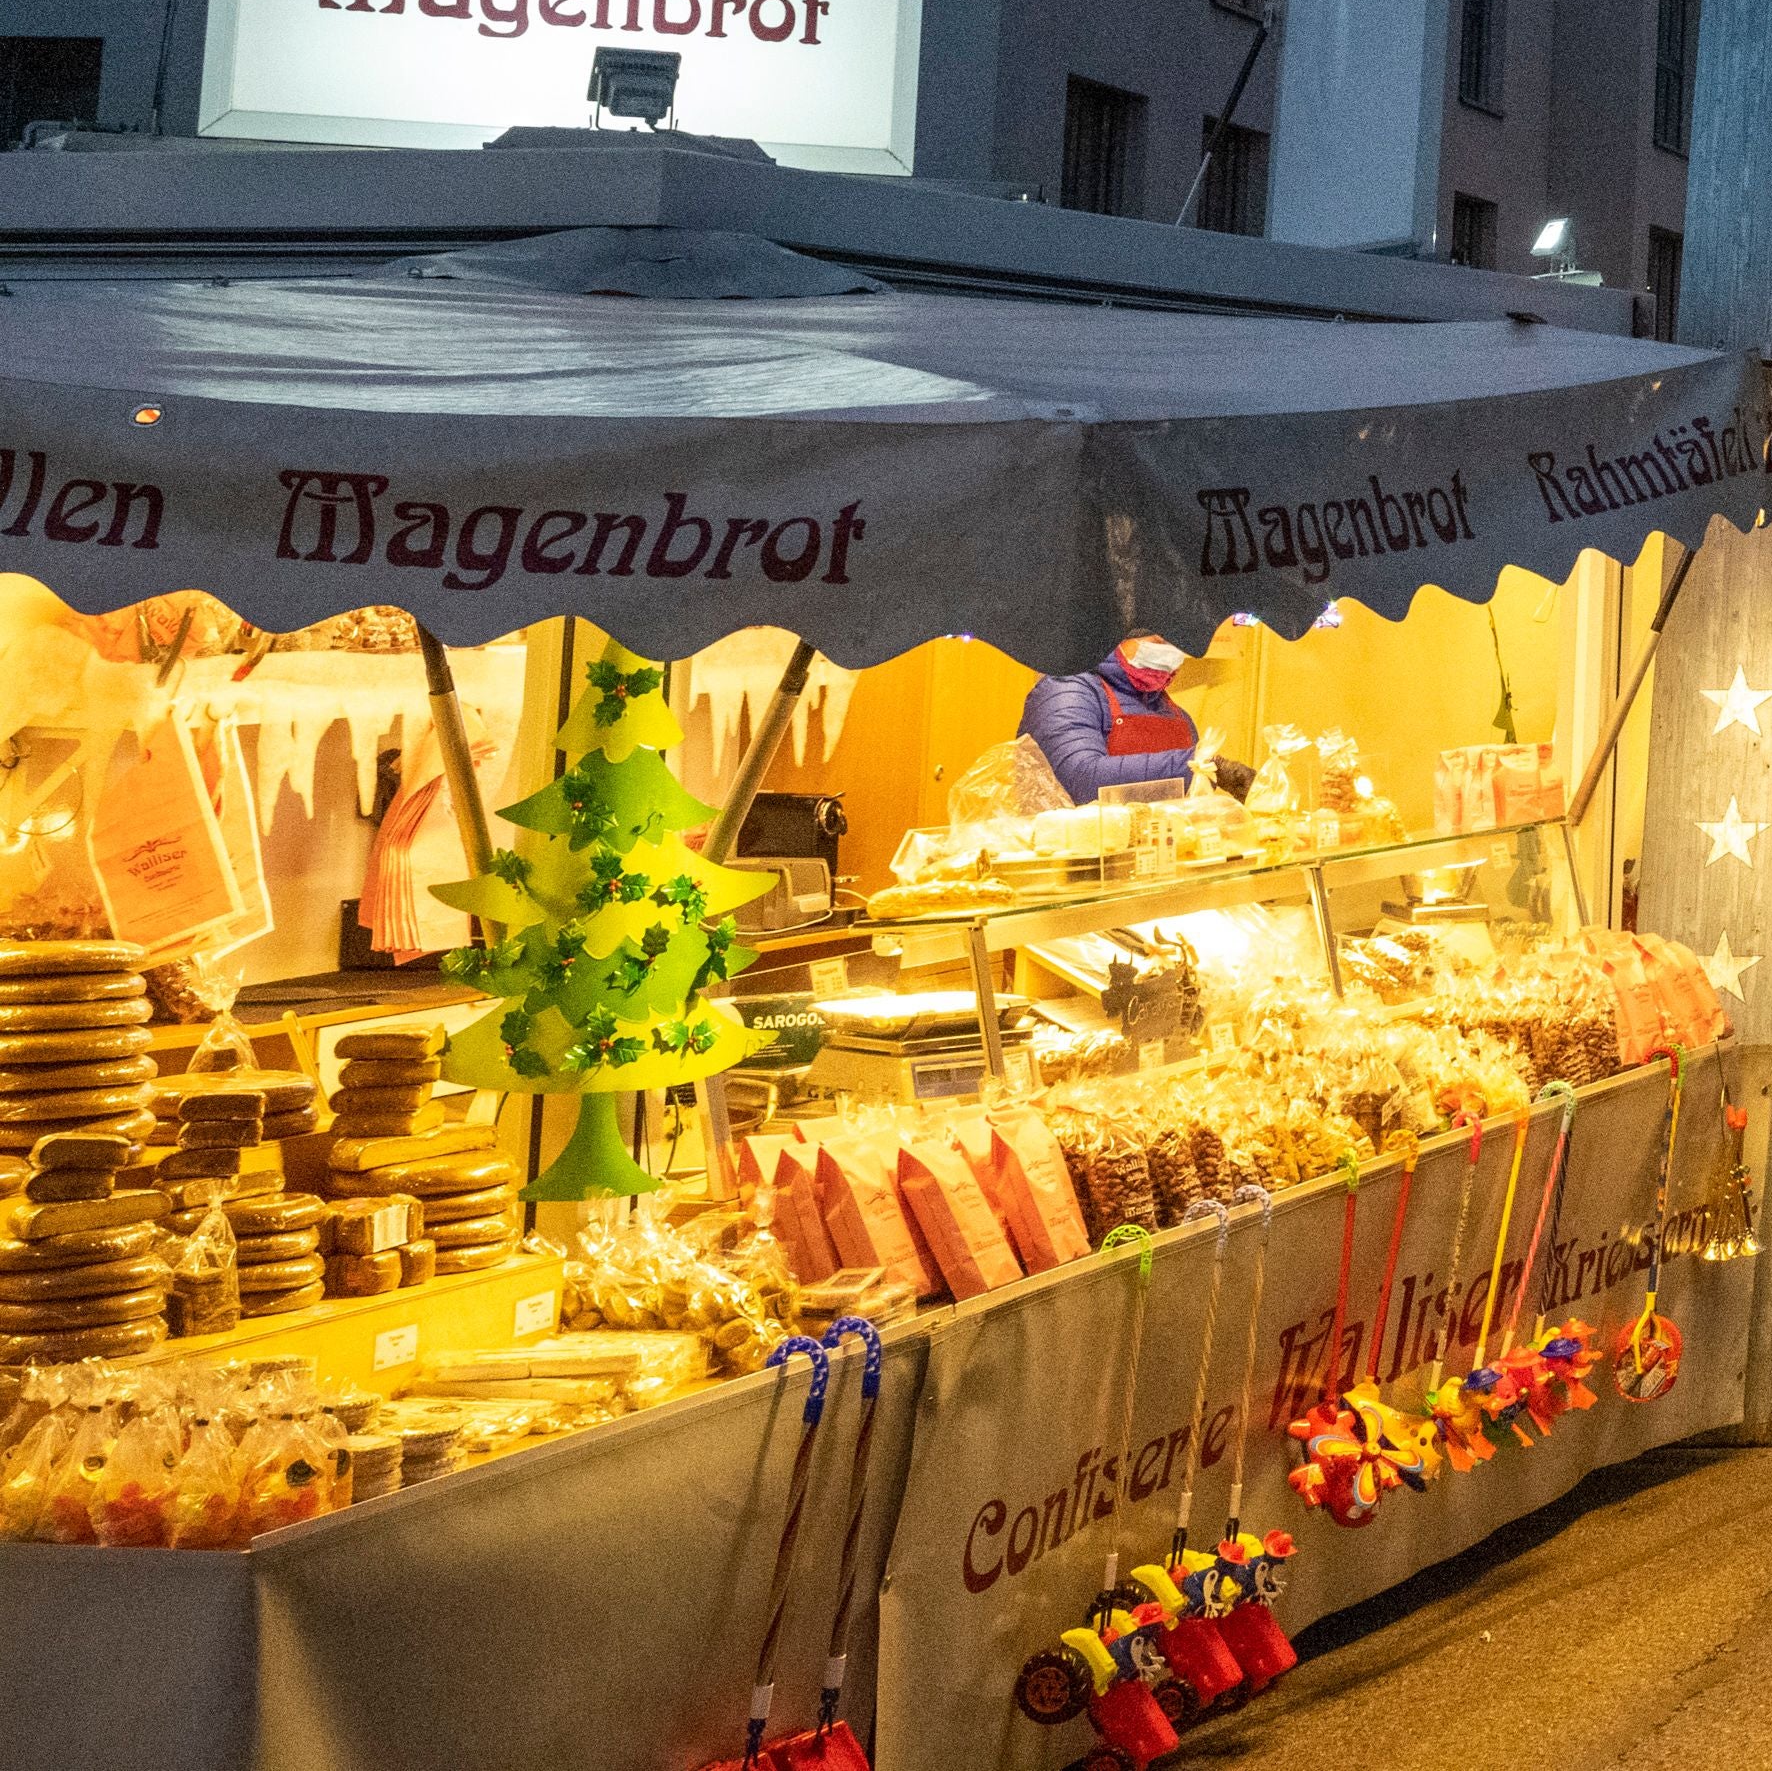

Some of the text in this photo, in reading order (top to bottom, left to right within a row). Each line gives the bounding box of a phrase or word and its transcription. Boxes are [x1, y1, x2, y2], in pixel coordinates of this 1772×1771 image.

[276, 468, 866, 590] Magenbrot
[1198, 466, 1478, 585] Magenbrot
[962, 1400, 1235, 1594] Confisere
[1267, 1259, 1522, 1434] Waliser
